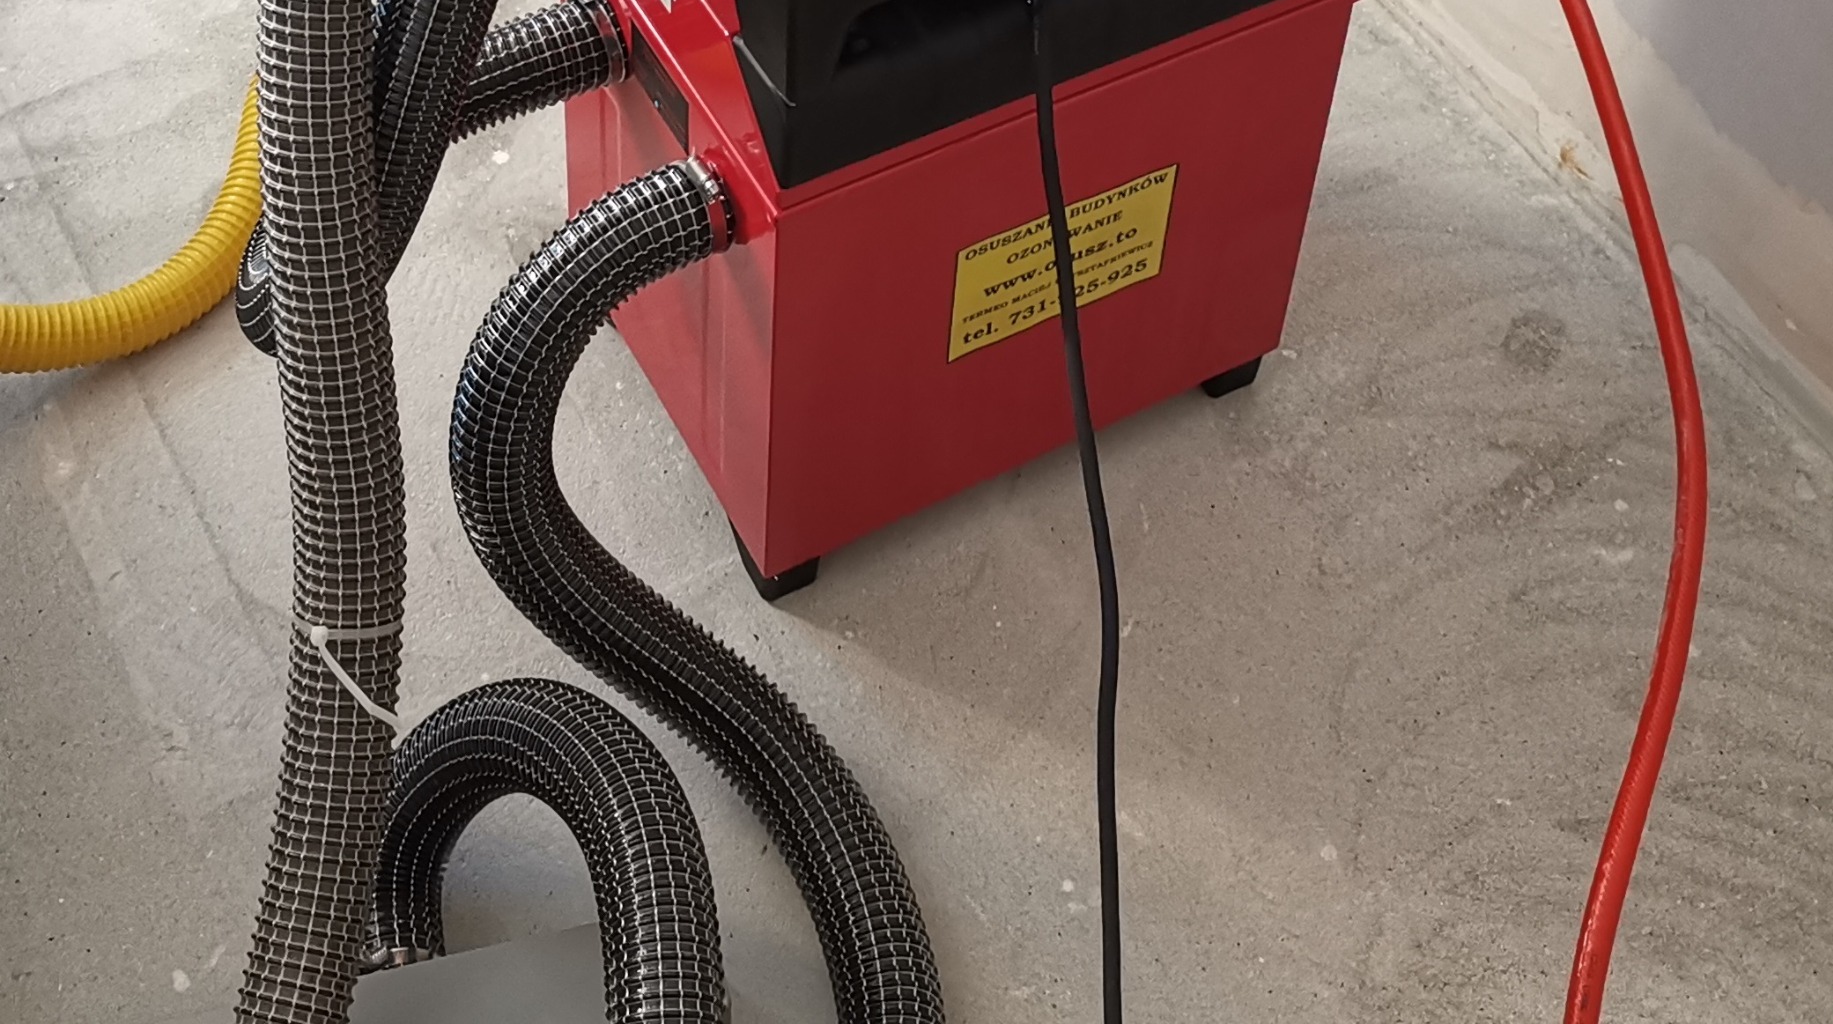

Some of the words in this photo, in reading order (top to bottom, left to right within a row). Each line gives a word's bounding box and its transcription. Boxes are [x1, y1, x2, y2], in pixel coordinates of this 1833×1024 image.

[965, 217, 1054, 261] OSUSZANI
[1069, 172, 1169, 219] BUDYNKÓW
[1006, 209, 1124, 265] OZONWANIE
[983, 226, 1138, 298] www.ousz.to
[961, 301, 1009, 325] TERMEO
[1011, 281, 1053, 305] MACIEJ
[962, 322, 999, 345] tel.
